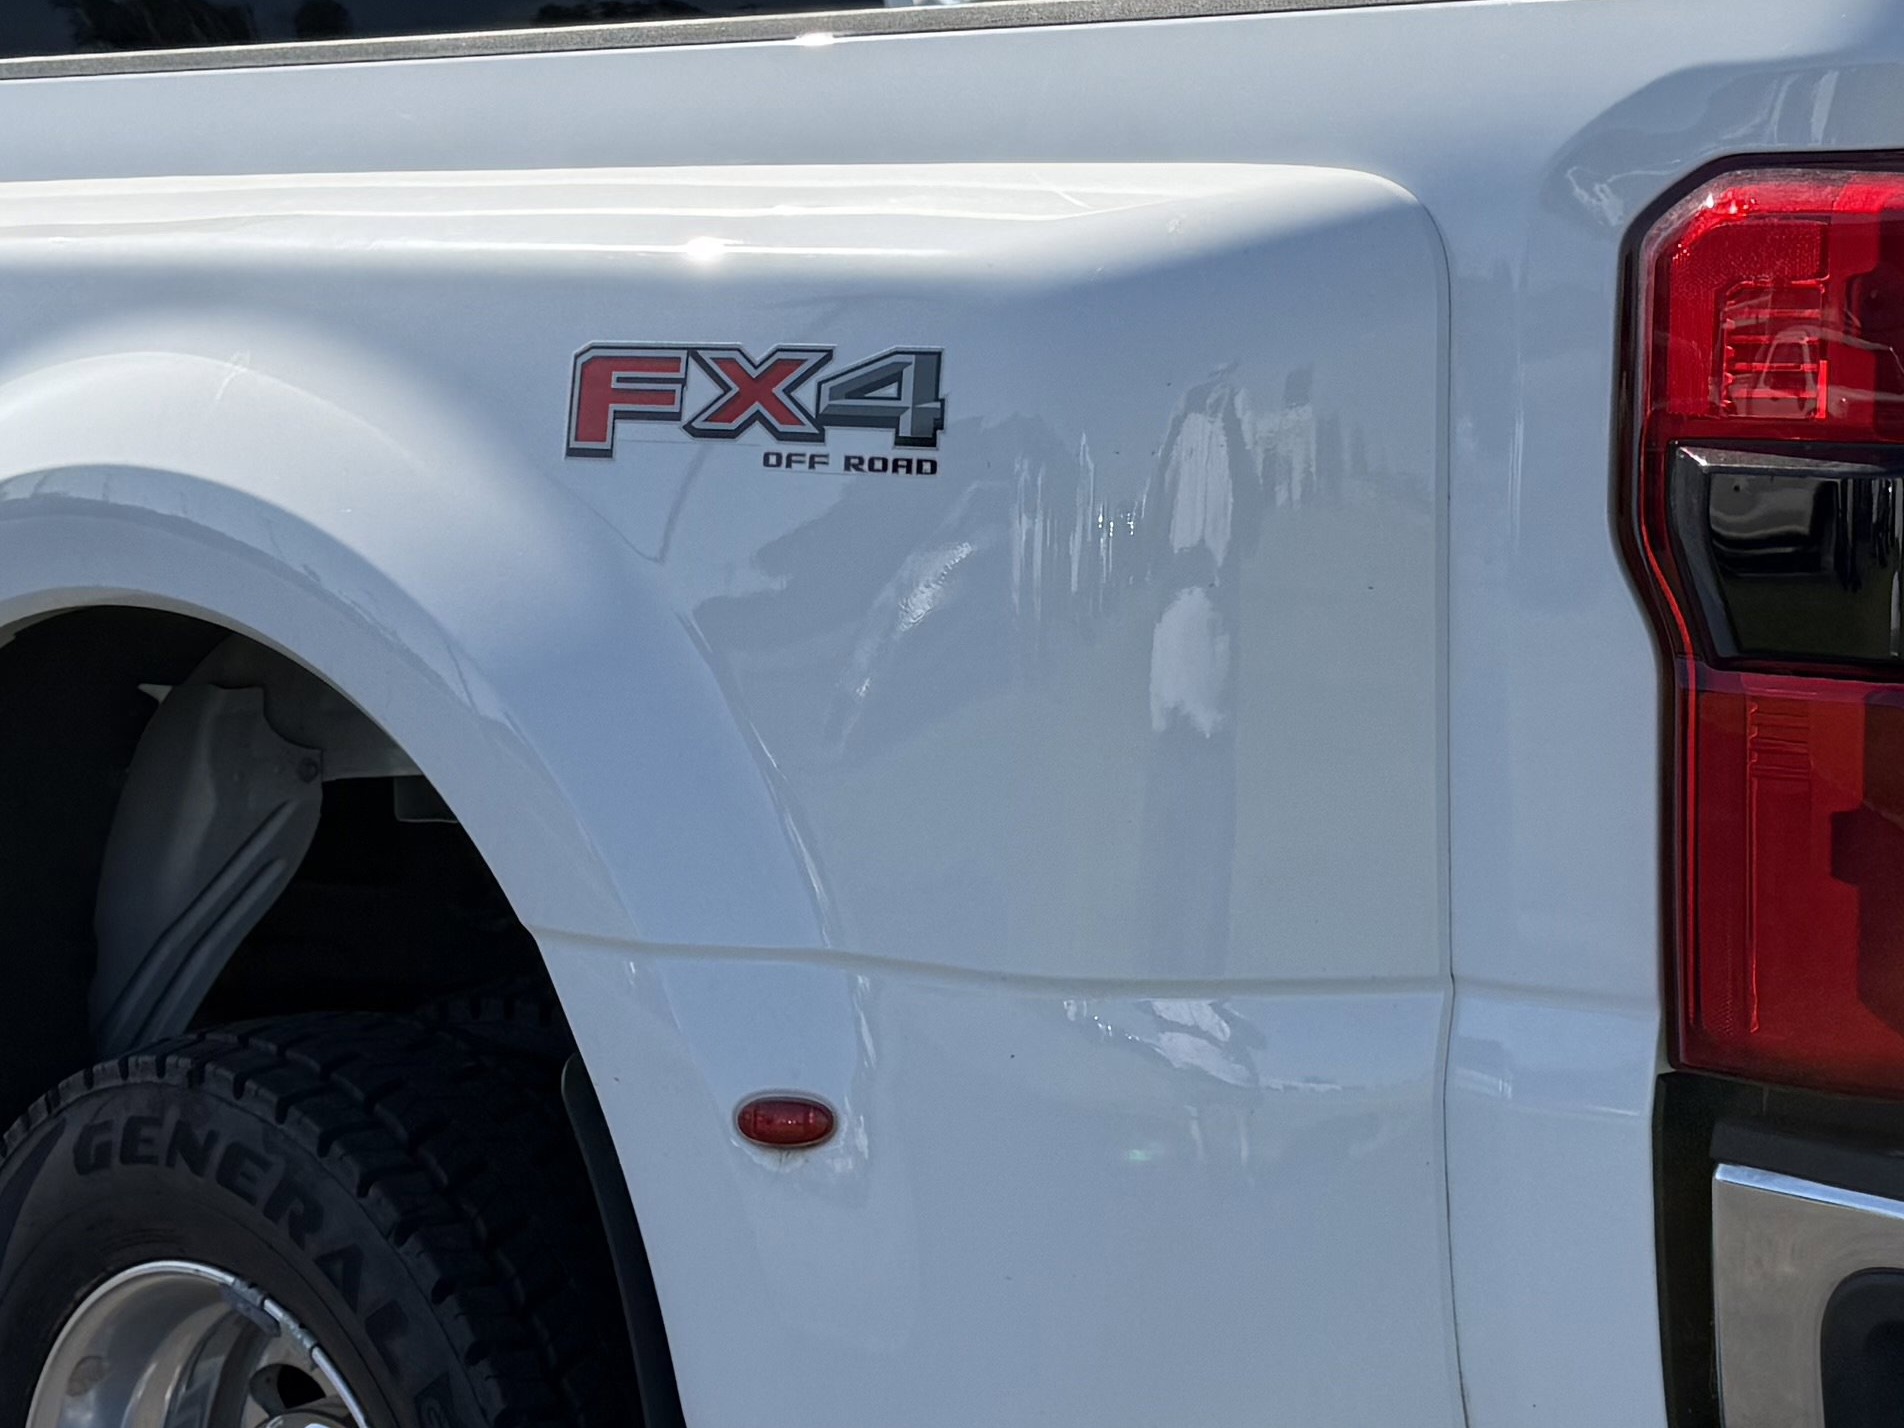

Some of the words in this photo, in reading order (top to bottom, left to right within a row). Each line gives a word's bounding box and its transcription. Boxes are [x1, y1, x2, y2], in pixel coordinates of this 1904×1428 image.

[565, 341, 947, 459] FX4
[762, 452, 830, 471] OFF
[843, 454, 939, 476] ROAD
[72, 1114, 412, 1378] GENERAL
